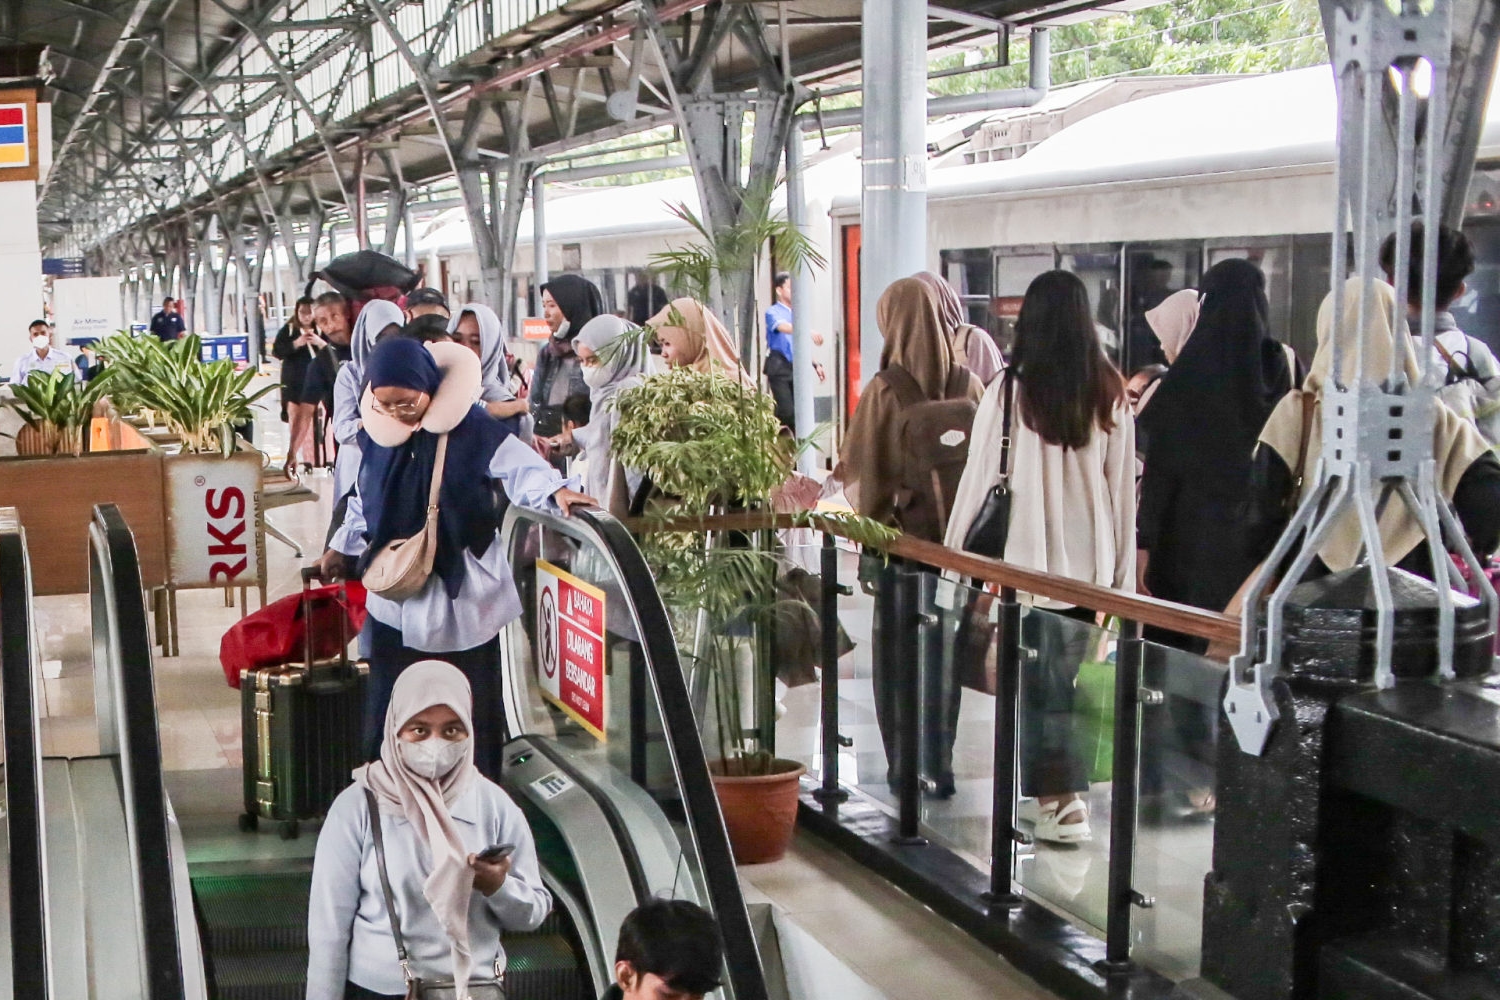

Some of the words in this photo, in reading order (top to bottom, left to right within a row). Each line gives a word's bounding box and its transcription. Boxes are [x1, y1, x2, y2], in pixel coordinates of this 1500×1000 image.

[205, 486, 248, 583] RKS
[566, 629, 594, 664] DILARANG
[565, 659, 596, 698] BERSANDAR
